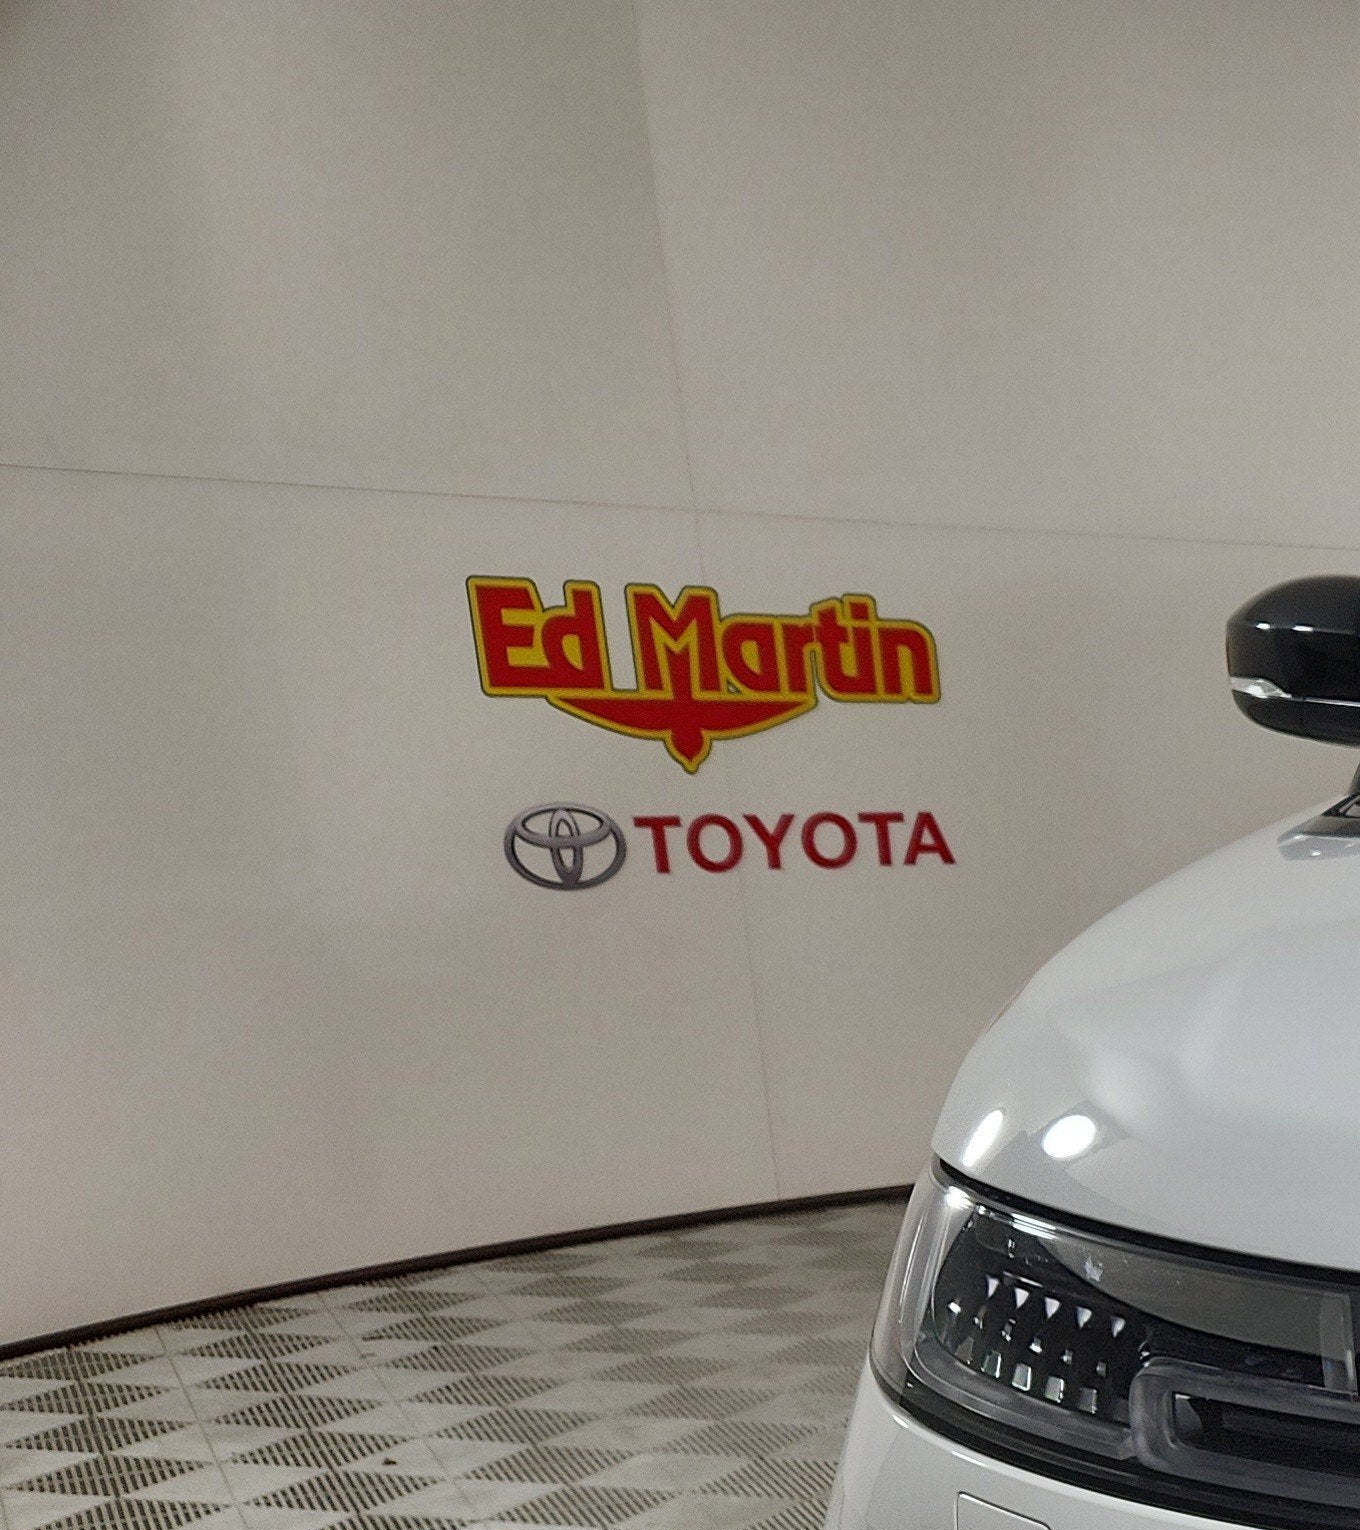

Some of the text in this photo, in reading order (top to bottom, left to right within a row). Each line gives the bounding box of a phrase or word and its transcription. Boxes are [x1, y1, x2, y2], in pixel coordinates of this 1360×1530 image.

[467, 576, 941, 703] Ed Martin
[633, 811, 956, 875] TOYOTA
